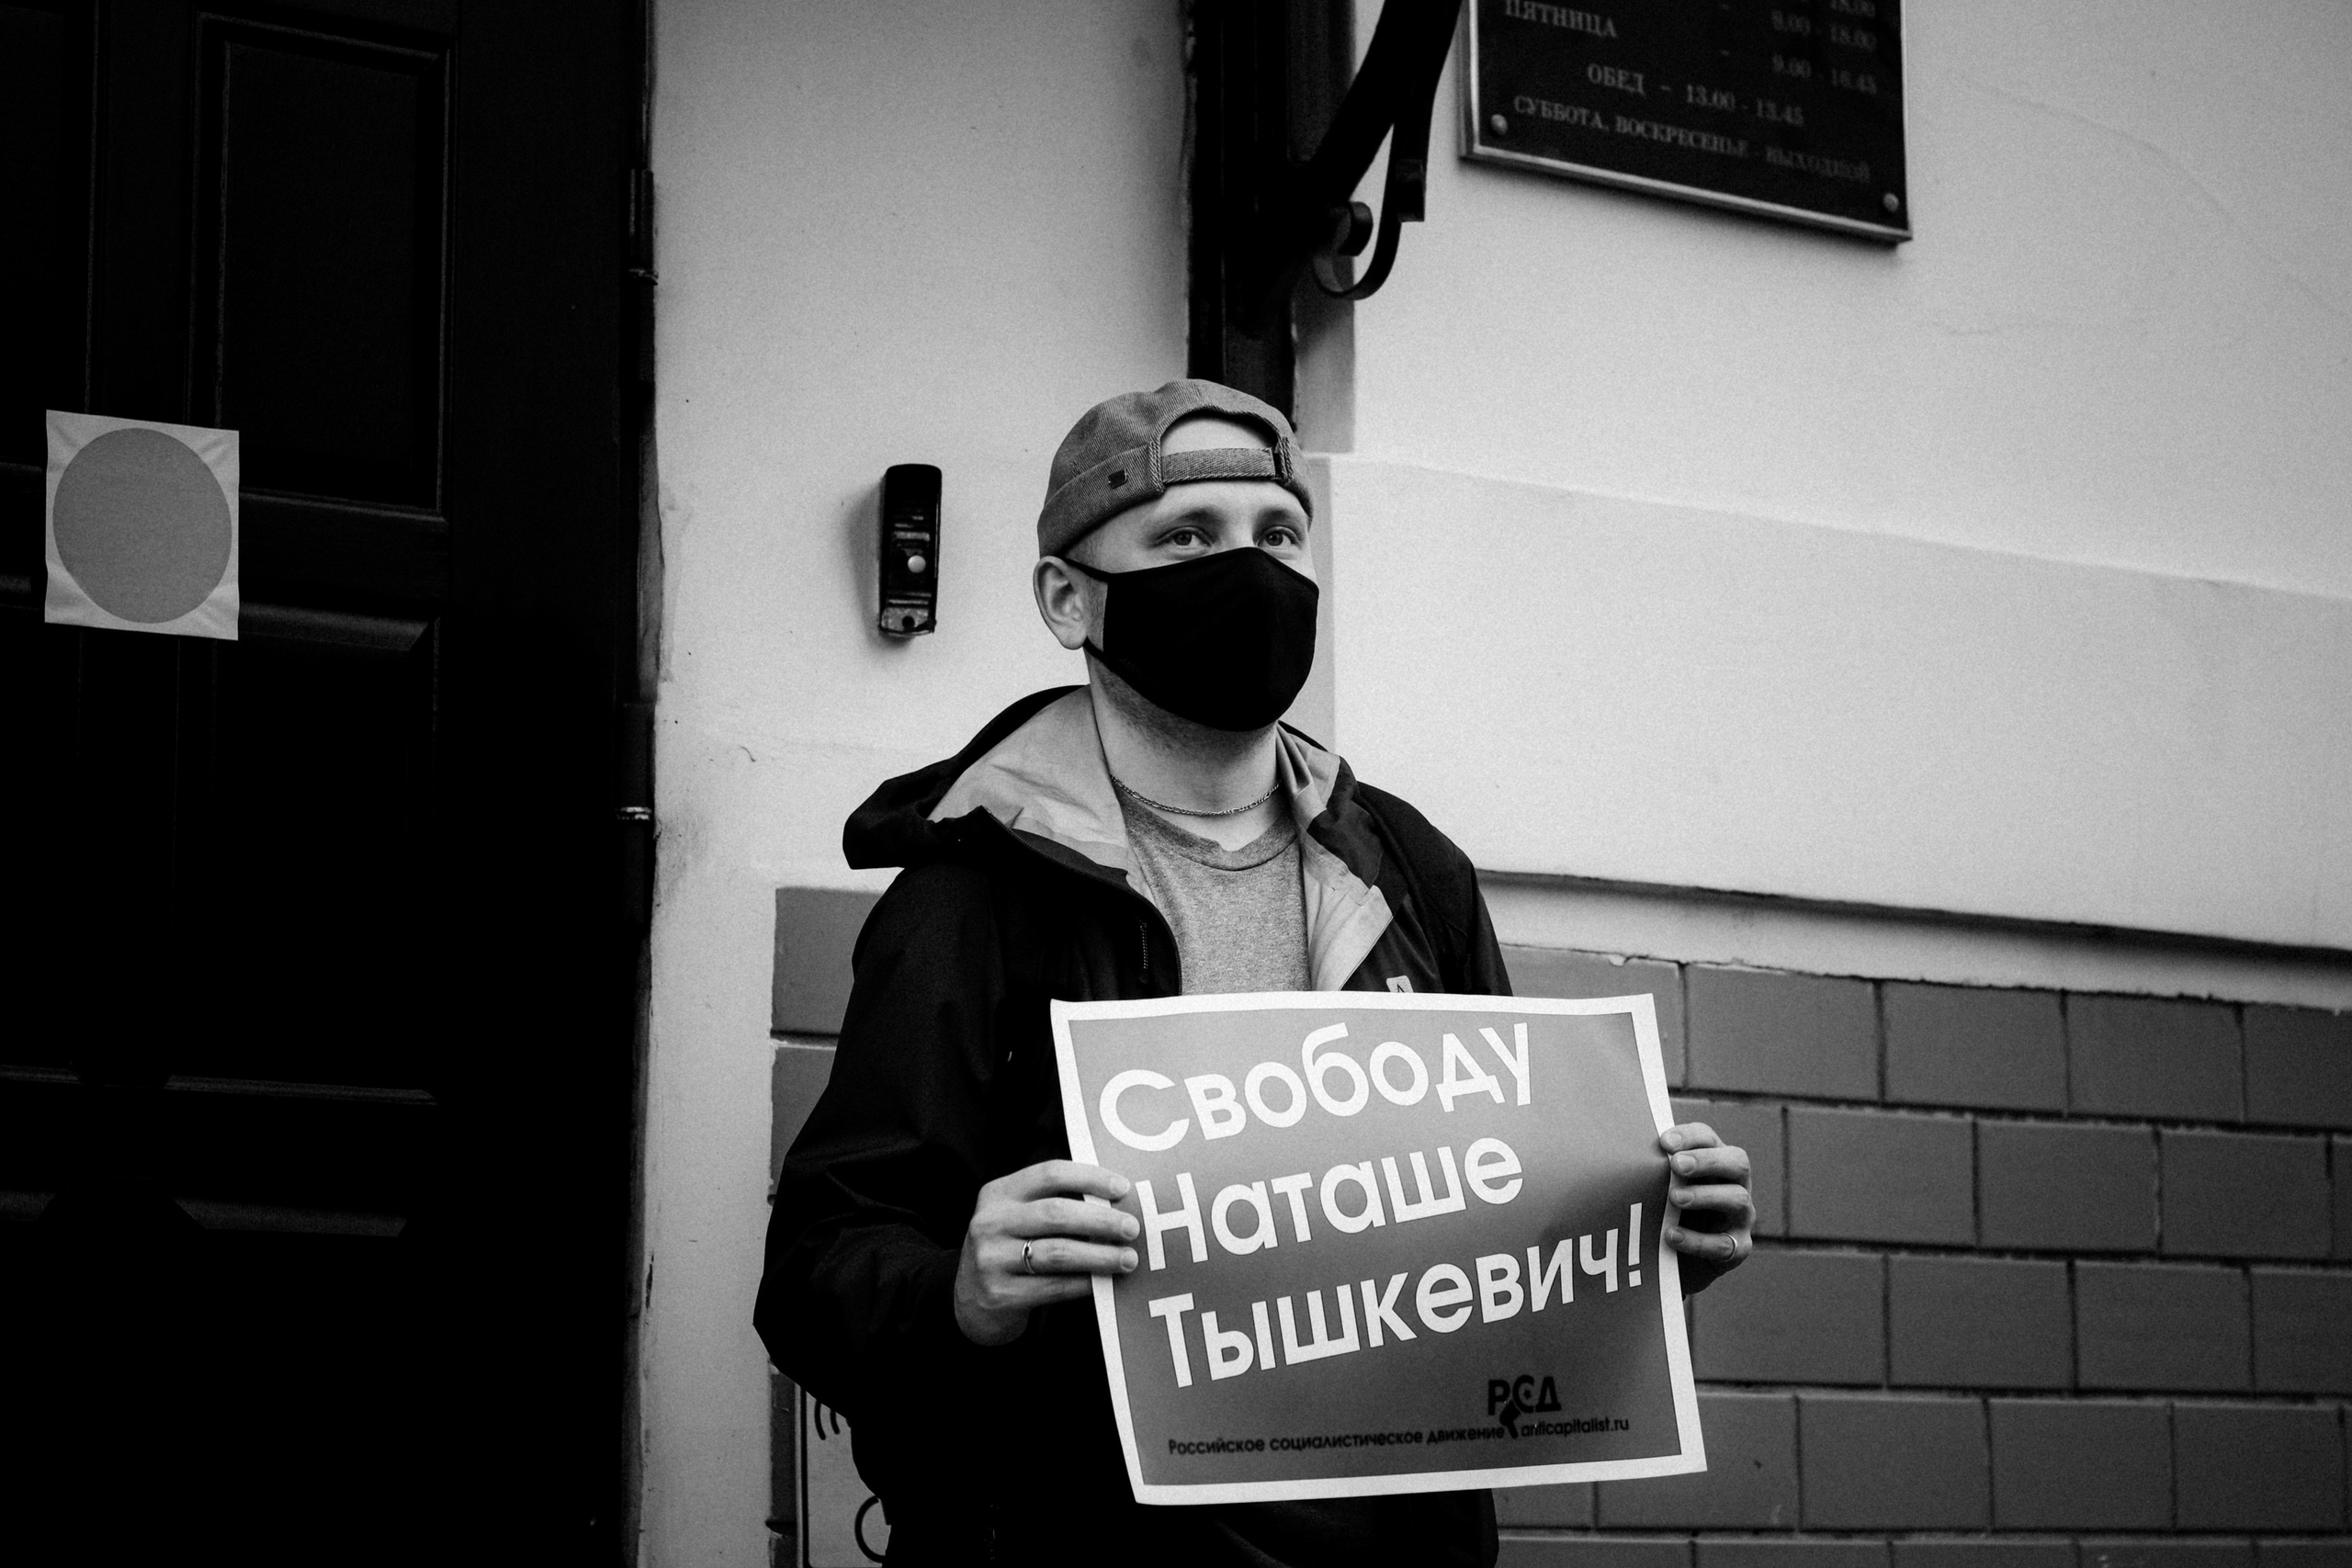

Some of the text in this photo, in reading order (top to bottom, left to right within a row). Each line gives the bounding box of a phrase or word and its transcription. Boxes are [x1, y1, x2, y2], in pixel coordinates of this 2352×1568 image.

[1505, 0, 1618, 39] ПЯТНИЦА
[1587, 62, 1646, 98] ОБЕД
[1687, 85, 1736, 112] 13.00
[1757, 98, 1804, 127] 13.45
[1614, 115, 1748, 158] ВОСКРЕСЕНЬЕ
[1099, 1021, 1532, 1153] Свободу
[1135, 1137, 1523, 1271] Наташе
[1148, 1202, 1644, 1389] Тышкевич!
[1487, 1374, 1562, 1416] РСД
[1169, 1425, 1505, 1455] Российское социалистическое движение
[1521, 1416, 1630, 1438] anticapitalist.ru
